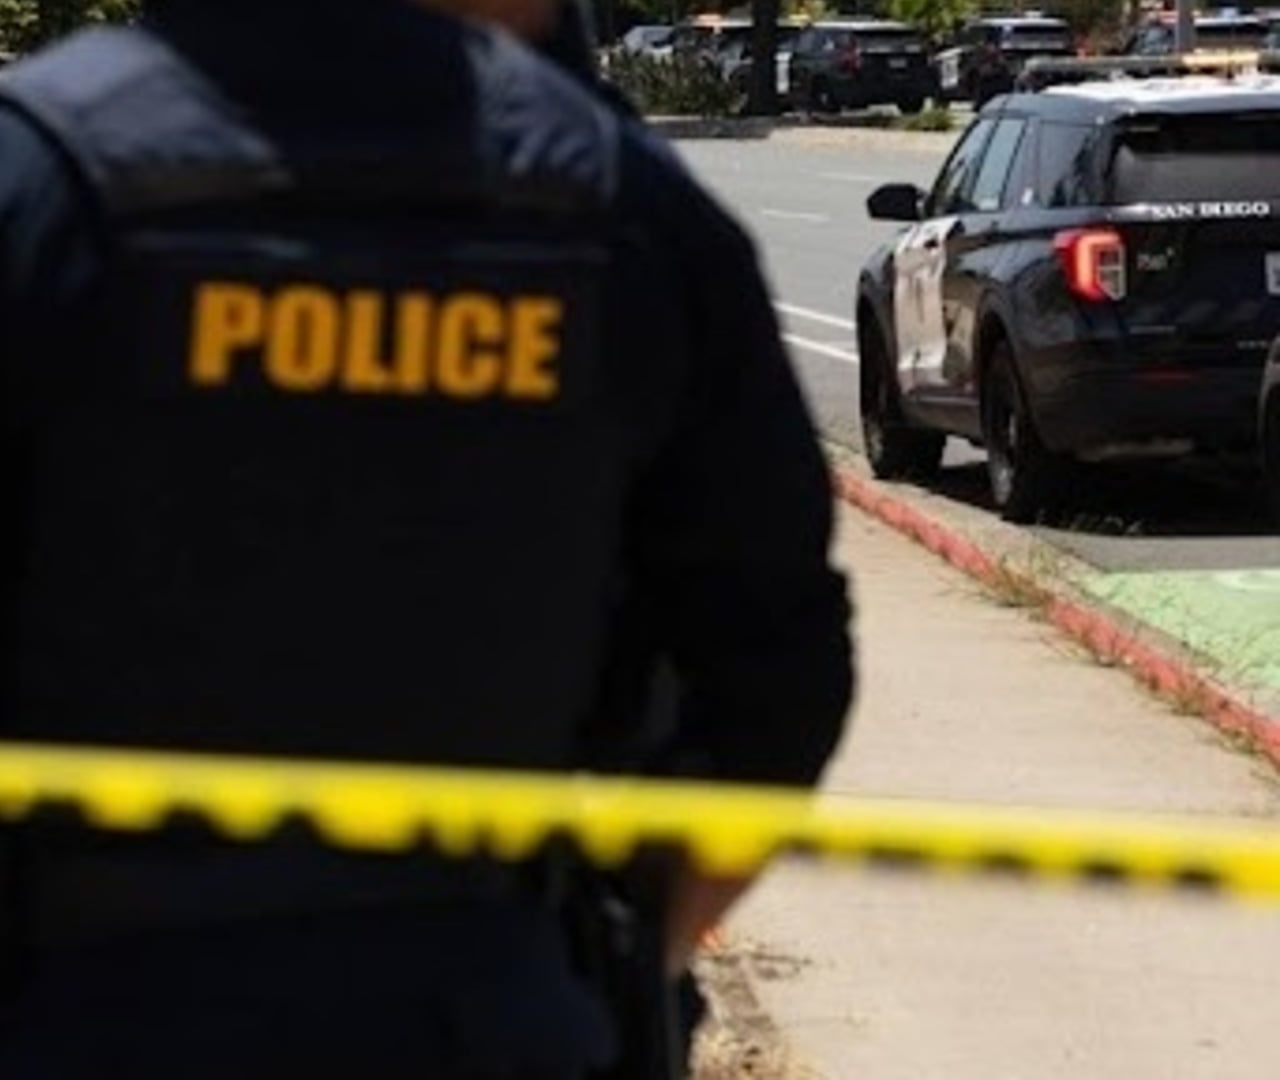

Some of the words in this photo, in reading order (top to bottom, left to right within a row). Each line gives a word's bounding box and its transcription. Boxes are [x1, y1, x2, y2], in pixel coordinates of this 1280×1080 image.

[1151, 202, 1194, 219] SAN
[1200, 201, 1270, 218] DIEGO
[191, 284, 560, 397] POLICE
